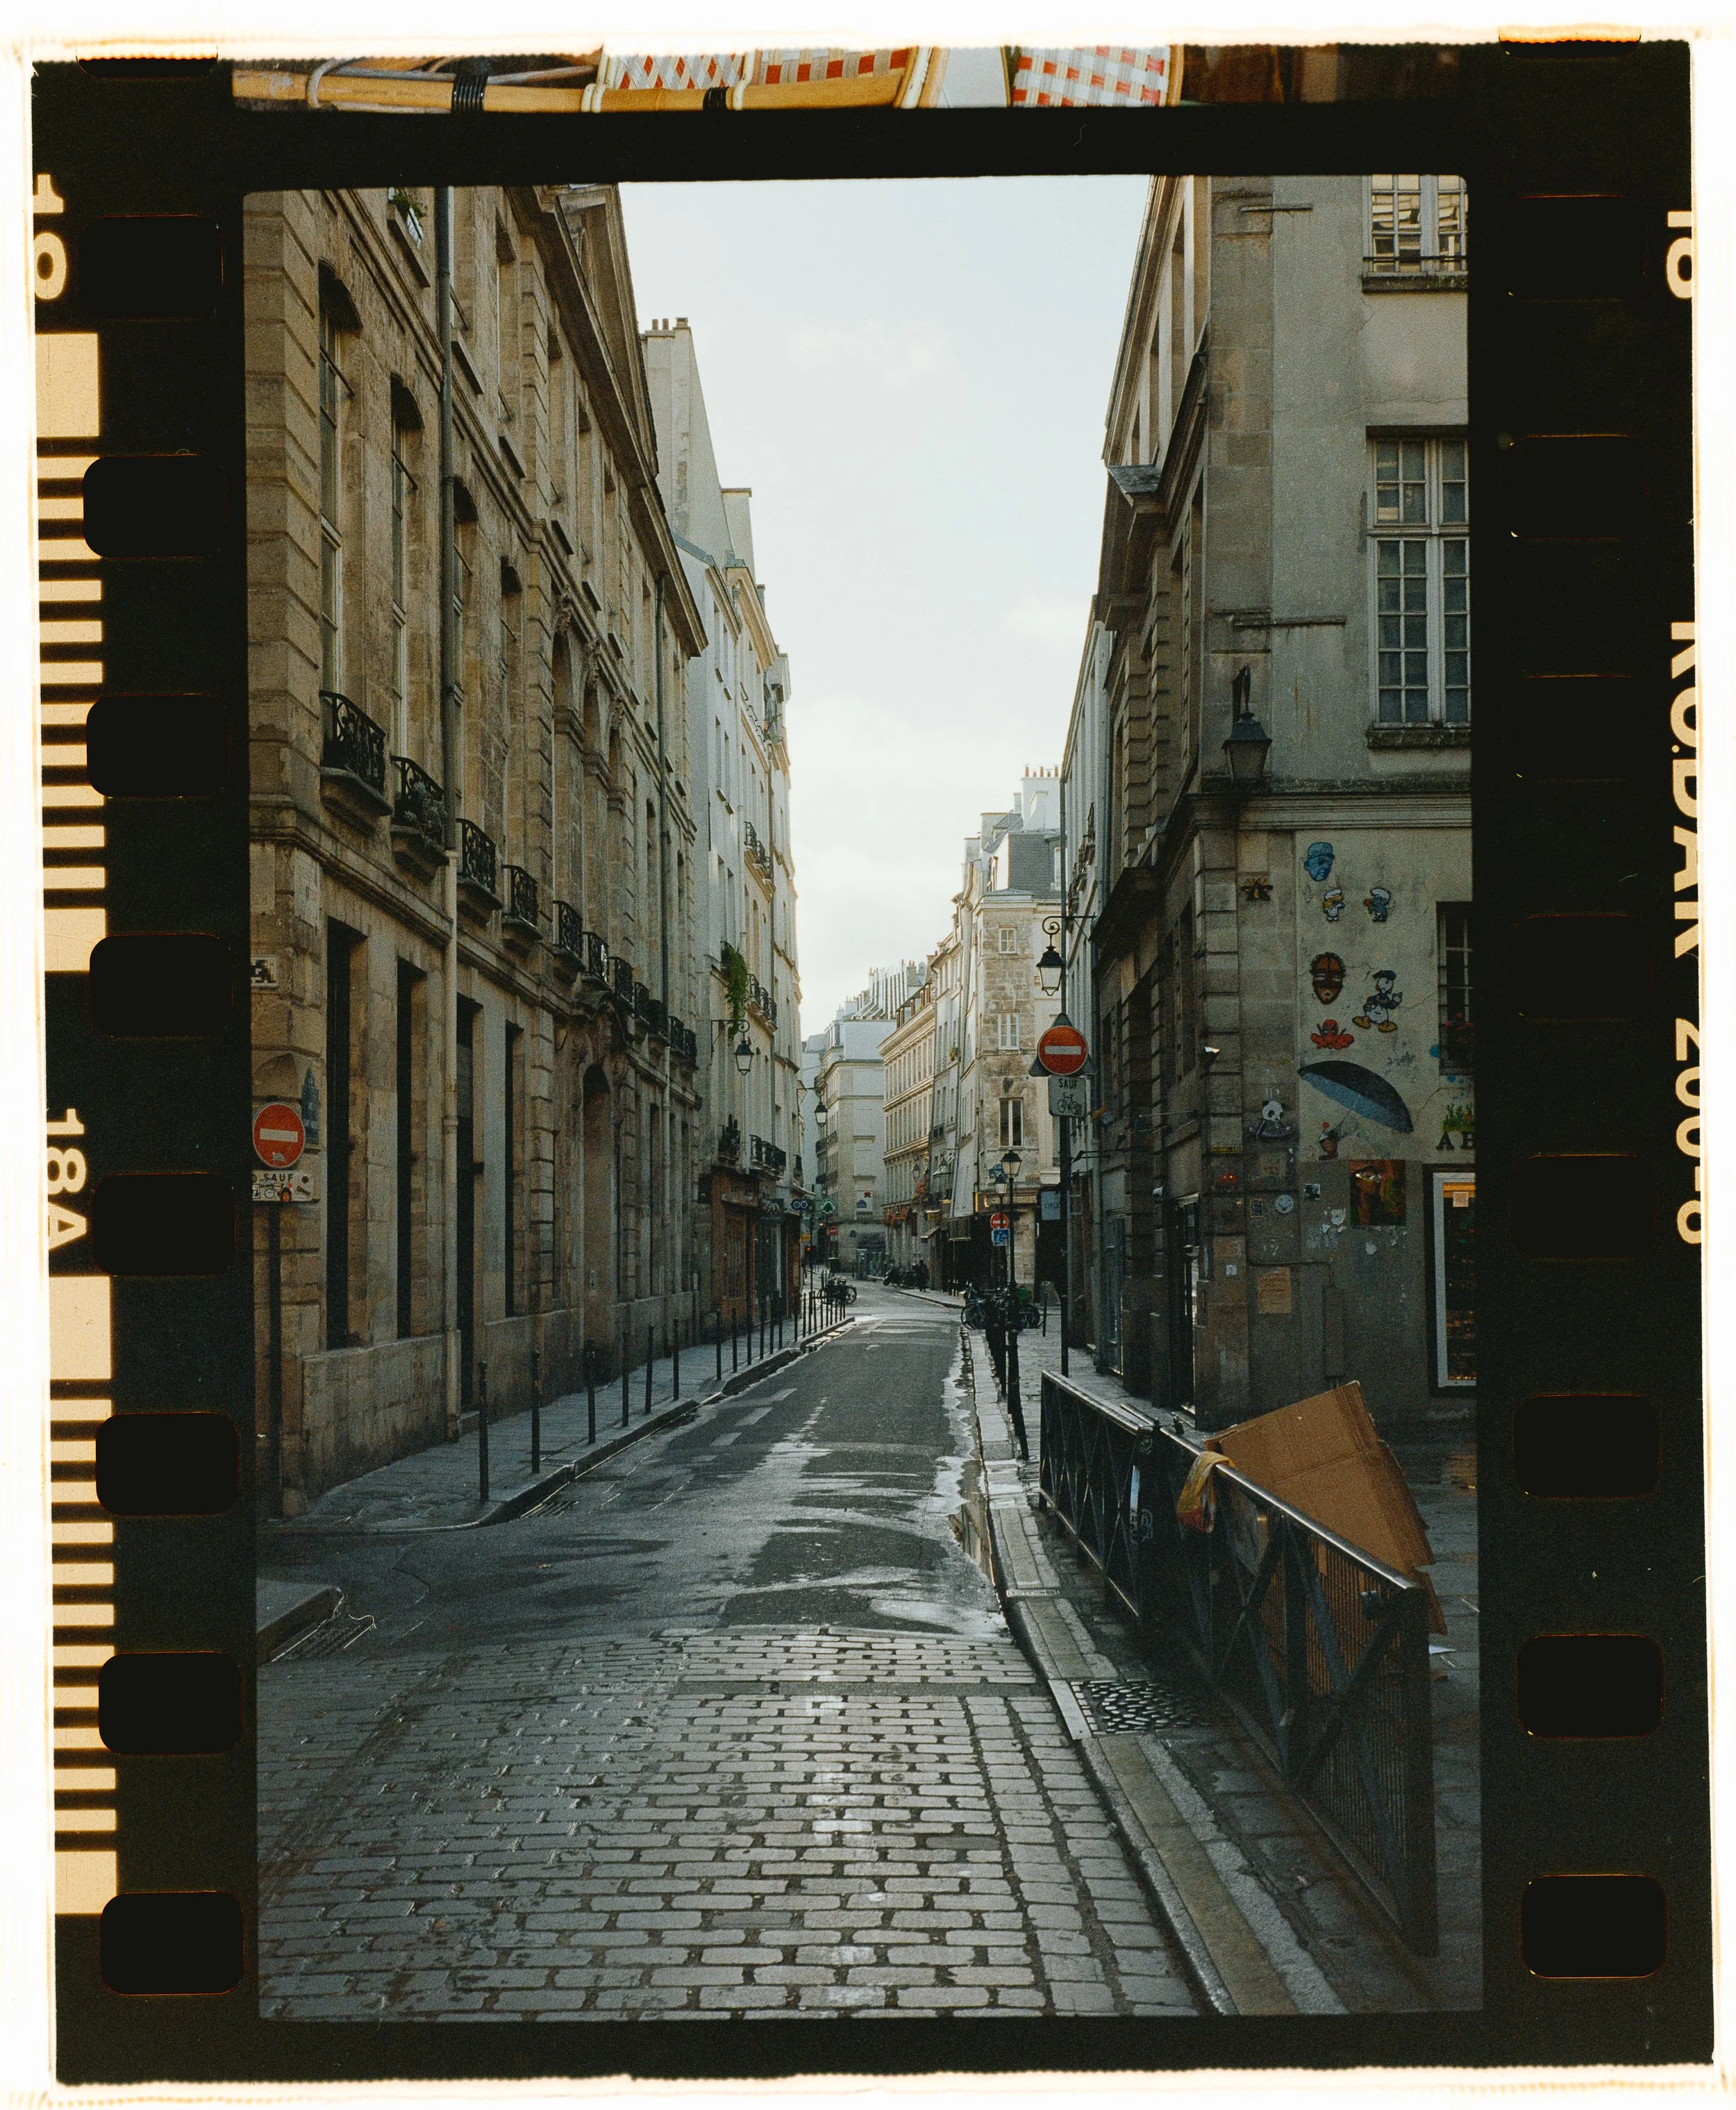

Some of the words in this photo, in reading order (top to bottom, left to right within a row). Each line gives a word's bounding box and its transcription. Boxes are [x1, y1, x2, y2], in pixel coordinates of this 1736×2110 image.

[1058, 1078, 1078, 1090] SAUF
[47, 1108, 87, 1250] 18A
[264, 1172, 294, 1182] SAUF
